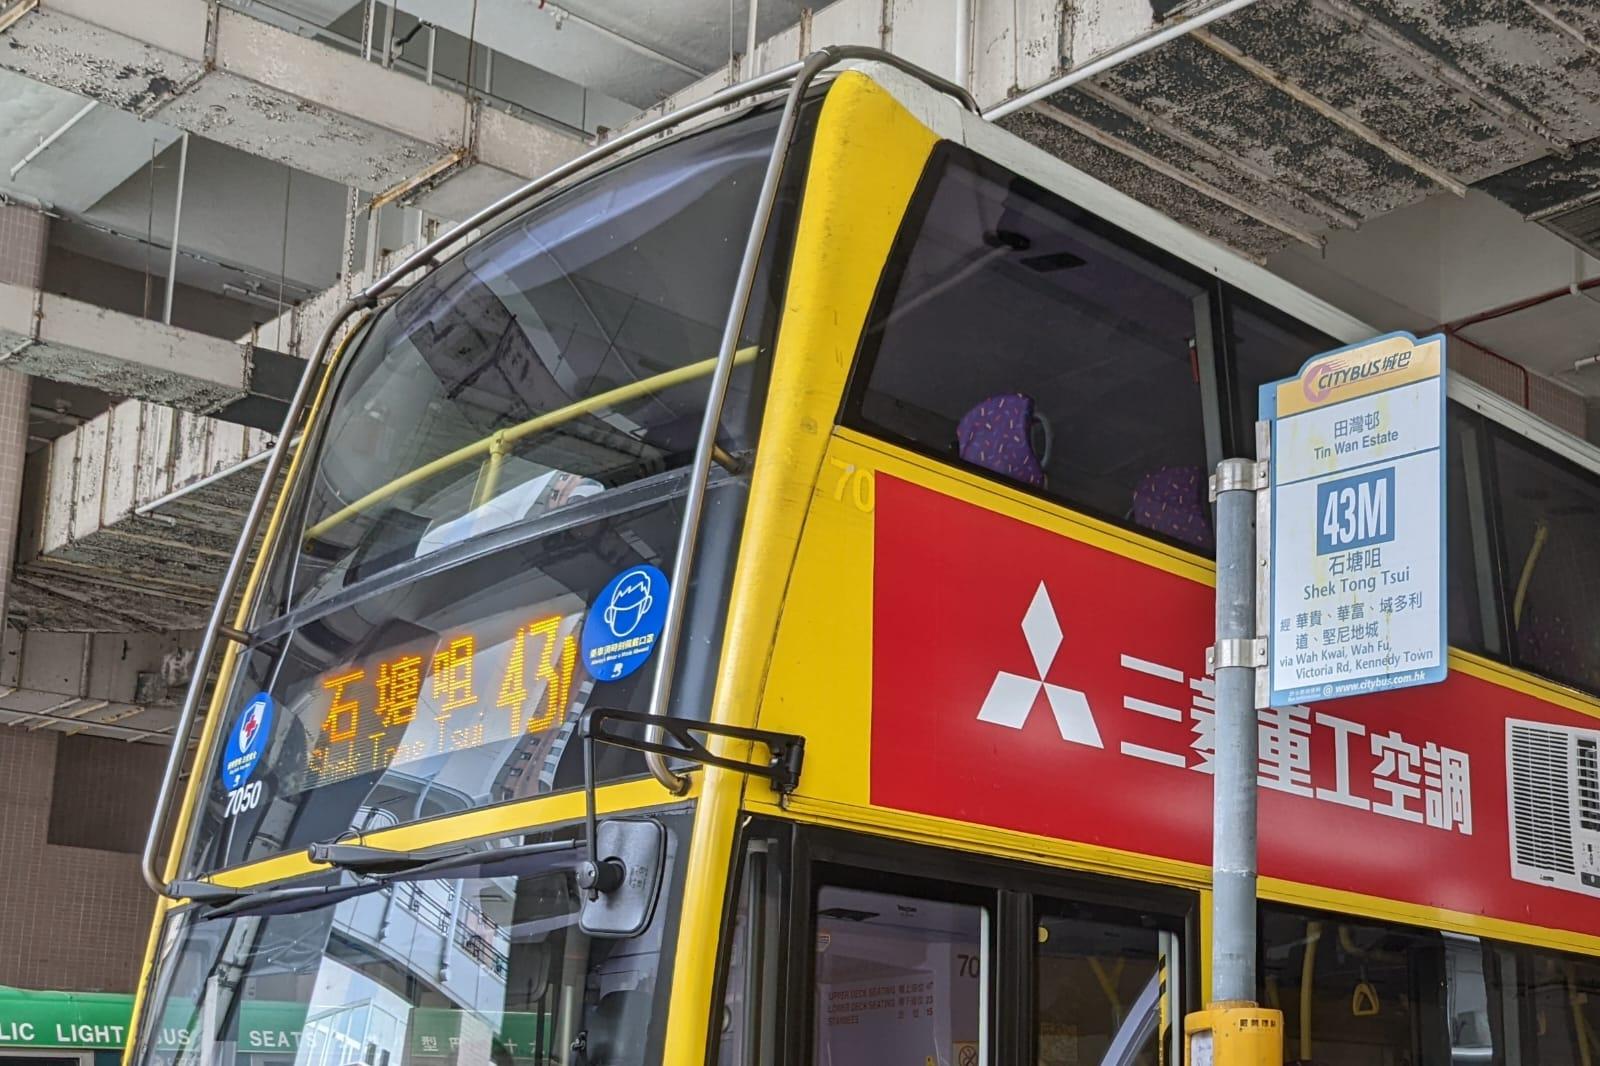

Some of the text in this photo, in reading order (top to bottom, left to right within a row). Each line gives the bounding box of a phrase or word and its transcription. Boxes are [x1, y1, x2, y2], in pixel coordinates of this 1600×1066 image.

[1318, 350, 1412, 390] CITYBUS 城巴
[1334, 411, 1380, 440] 田灣邨
[1314, 430, 1399, 460] Tin Wan Estate
[1323, 478, 1387, 546] 43M
[1328, 547, 1382, 577] 石塘咀
[1303, 566, 1411, 601] Shek Tong Tsui
[1295, 621, 1380, 651] 道、堅尼地城
[1280, 640, 1392, 668] via Wah Kwai, Wah Fu,
[1296, 649, 1434, 680] Victoria Rd, Kennedy Town
[321, 634, 479, 744] 石塘咀
[1335, 672, 1426, 693] www.citybus.com.hk
[223, 780, 263, 818] 7050
[56, 1023, 125, 1044] LIGHT
